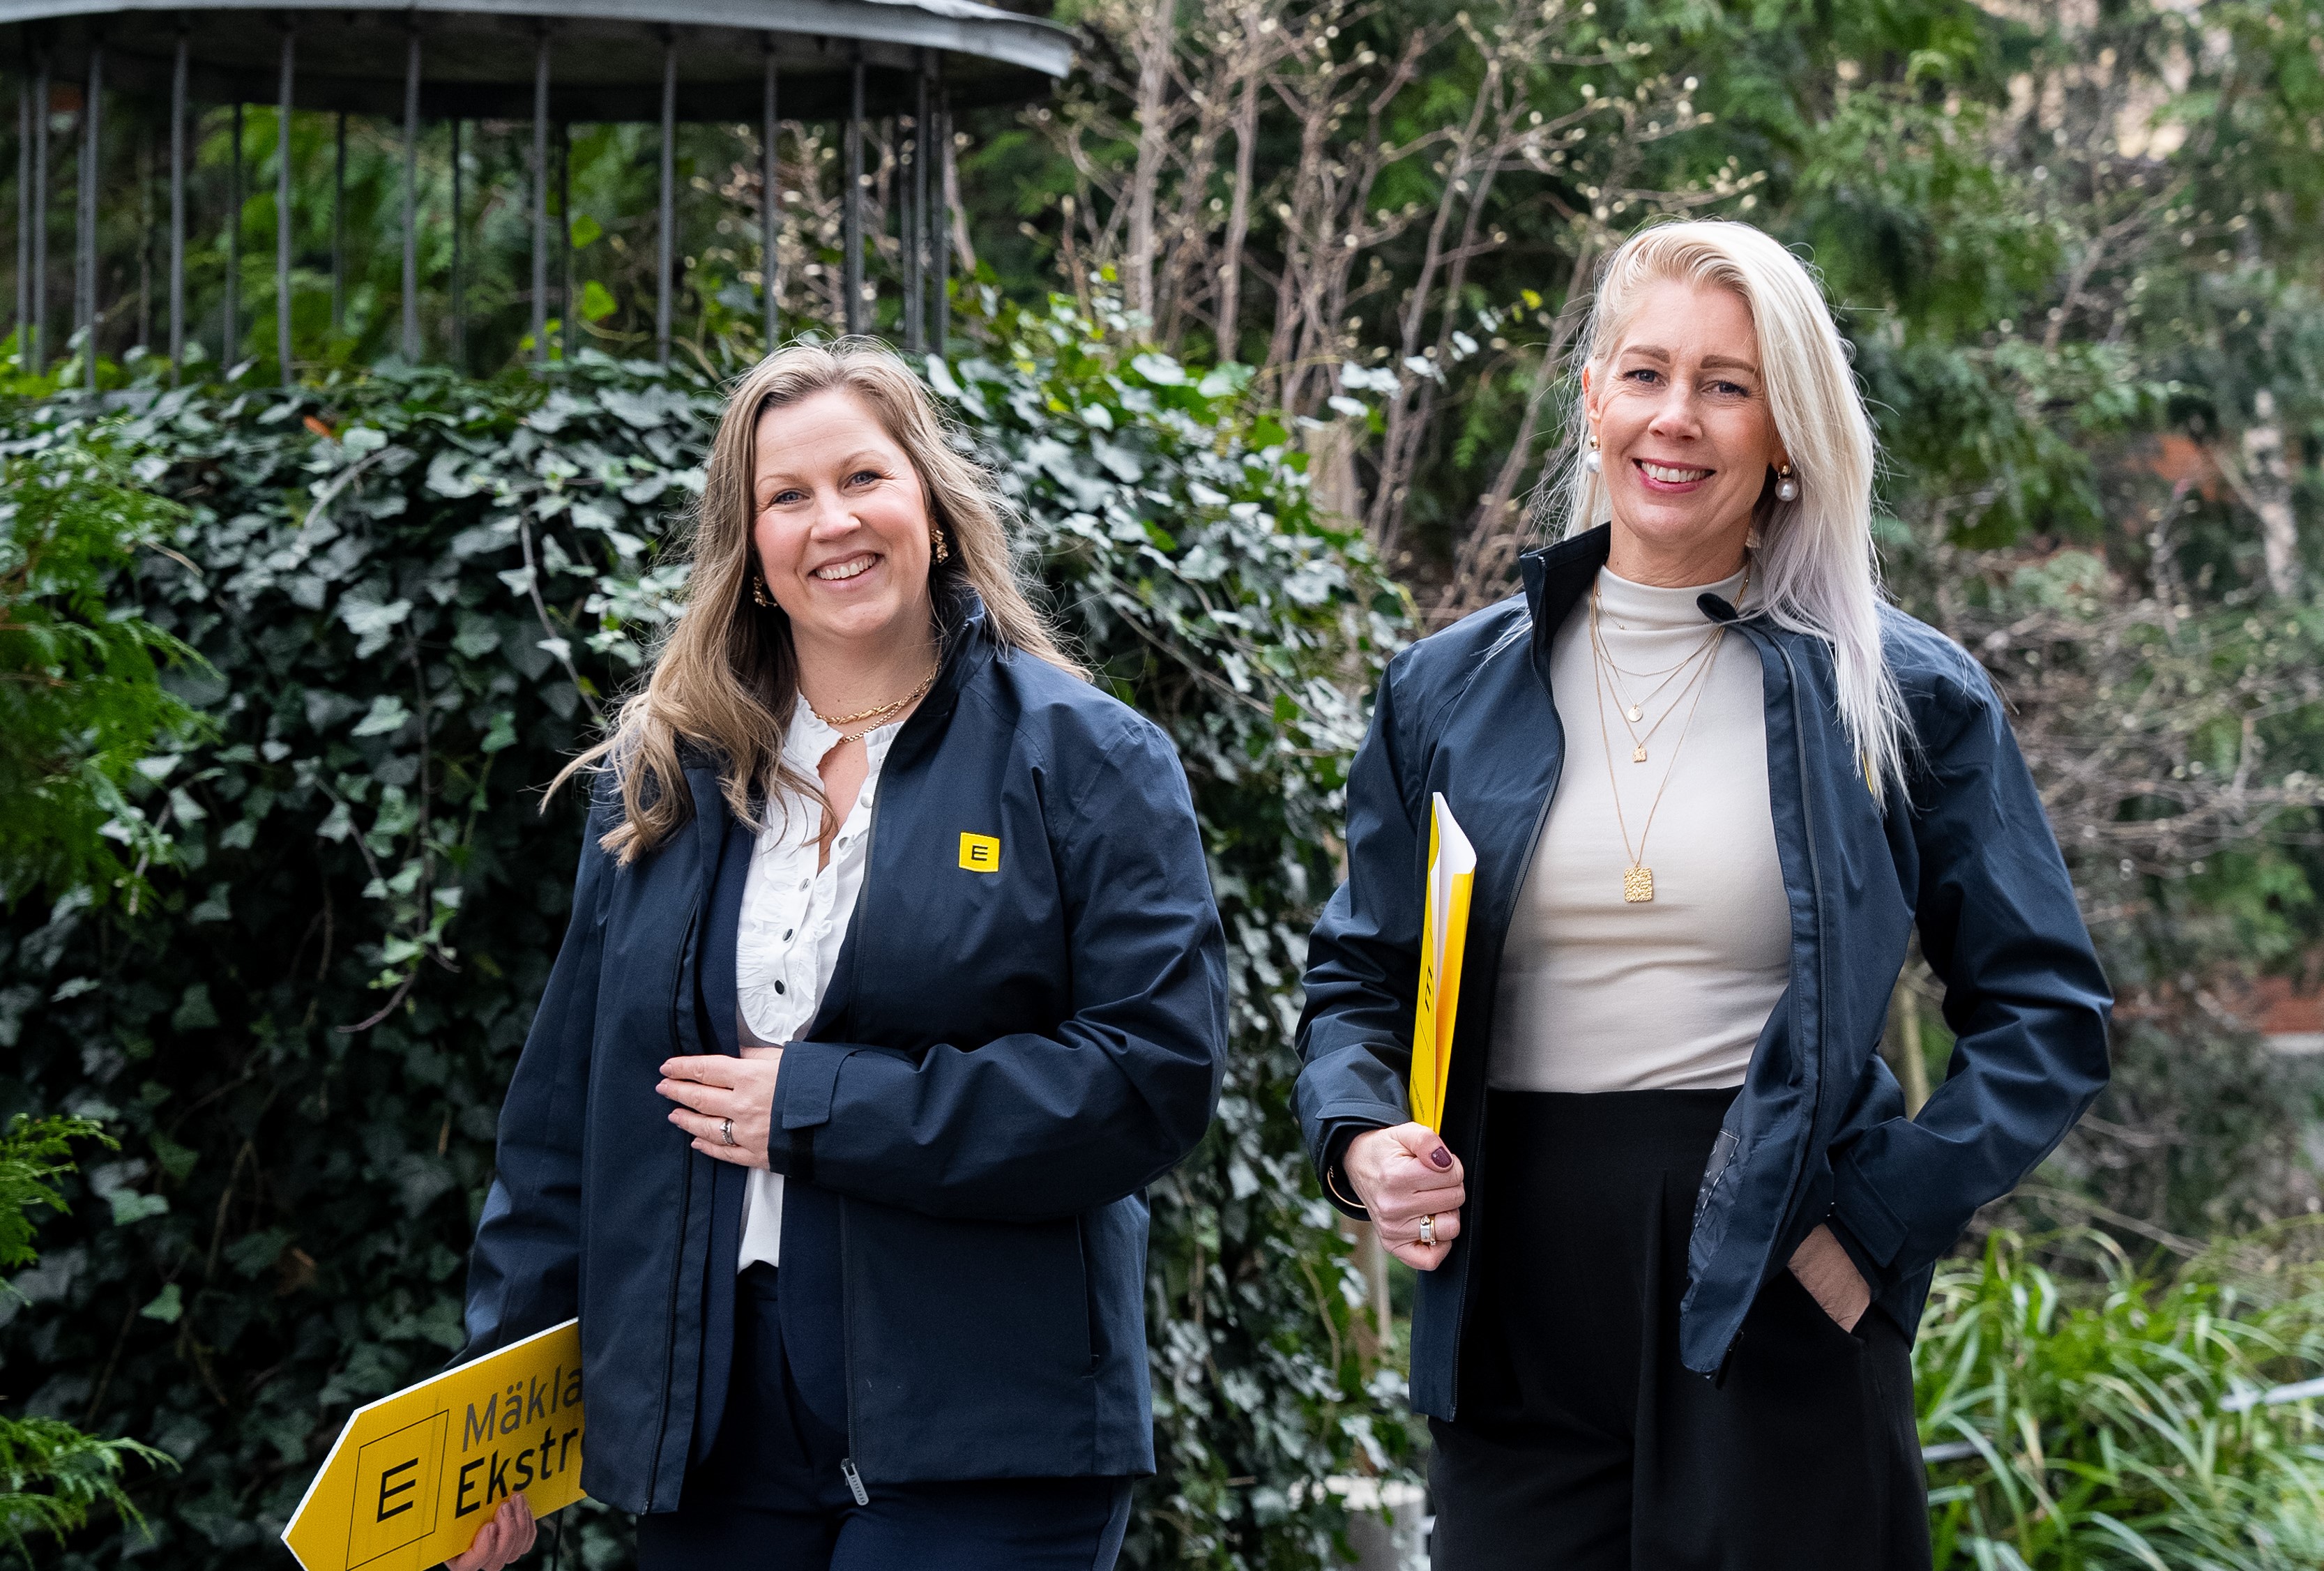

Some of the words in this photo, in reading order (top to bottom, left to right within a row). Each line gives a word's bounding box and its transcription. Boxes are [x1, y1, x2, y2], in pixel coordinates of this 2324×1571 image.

[971, 844, 988, 861] E
[462, 1365, 583, 1452] Mäkla
[377, 1457, 419, 1524] E
[455, 1428, 585, 1519] Ekstr
